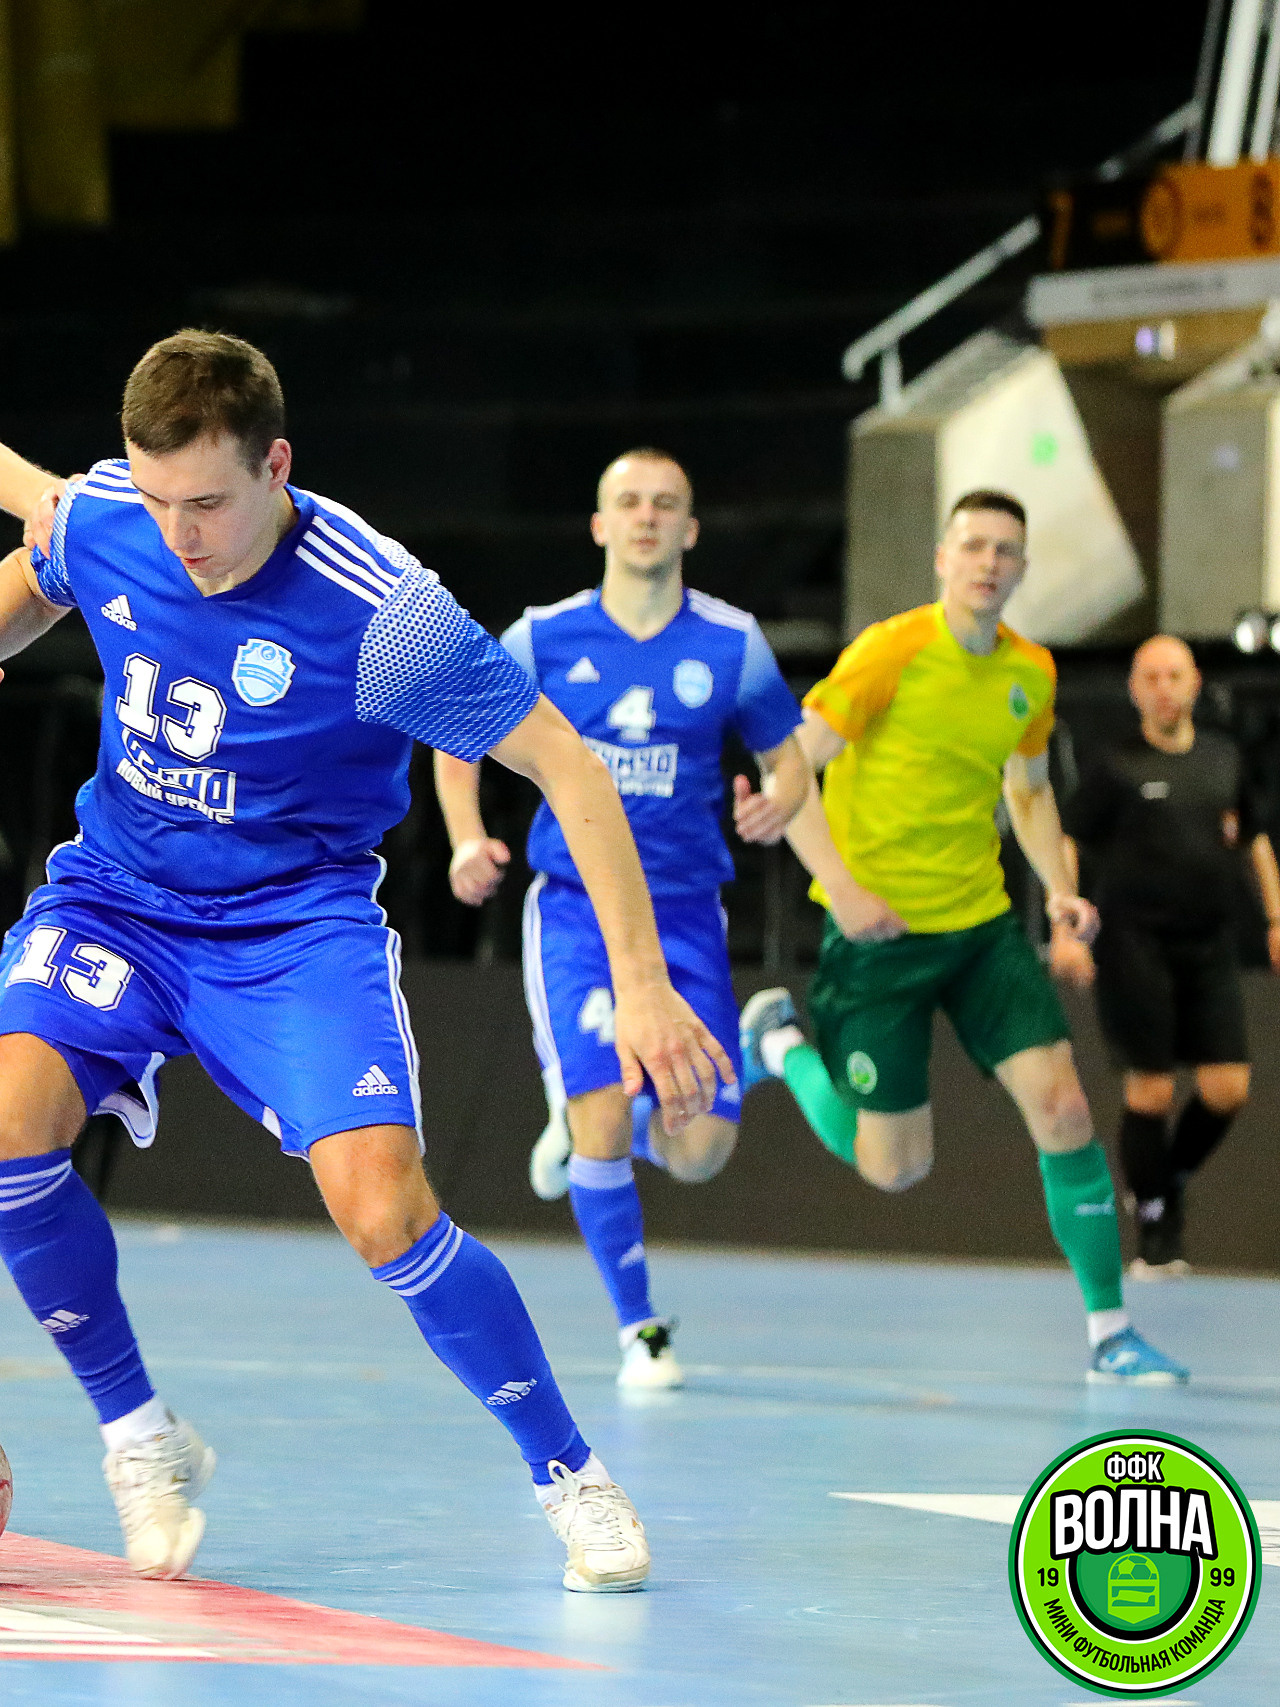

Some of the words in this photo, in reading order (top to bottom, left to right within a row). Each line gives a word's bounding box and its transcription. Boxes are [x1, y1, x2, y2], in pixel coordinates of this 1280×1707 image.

[101, 606, 138, 631] adidas
[116, 653, 227, 762] 13
[607, 685, 656, 743] 4
[116, 758, 164, 802] НОВЫЙ
[4, 924, 134, 1011] 13
[577, 987, 615, 1047] 4
[352, 1084, 399, 1097] adidas
